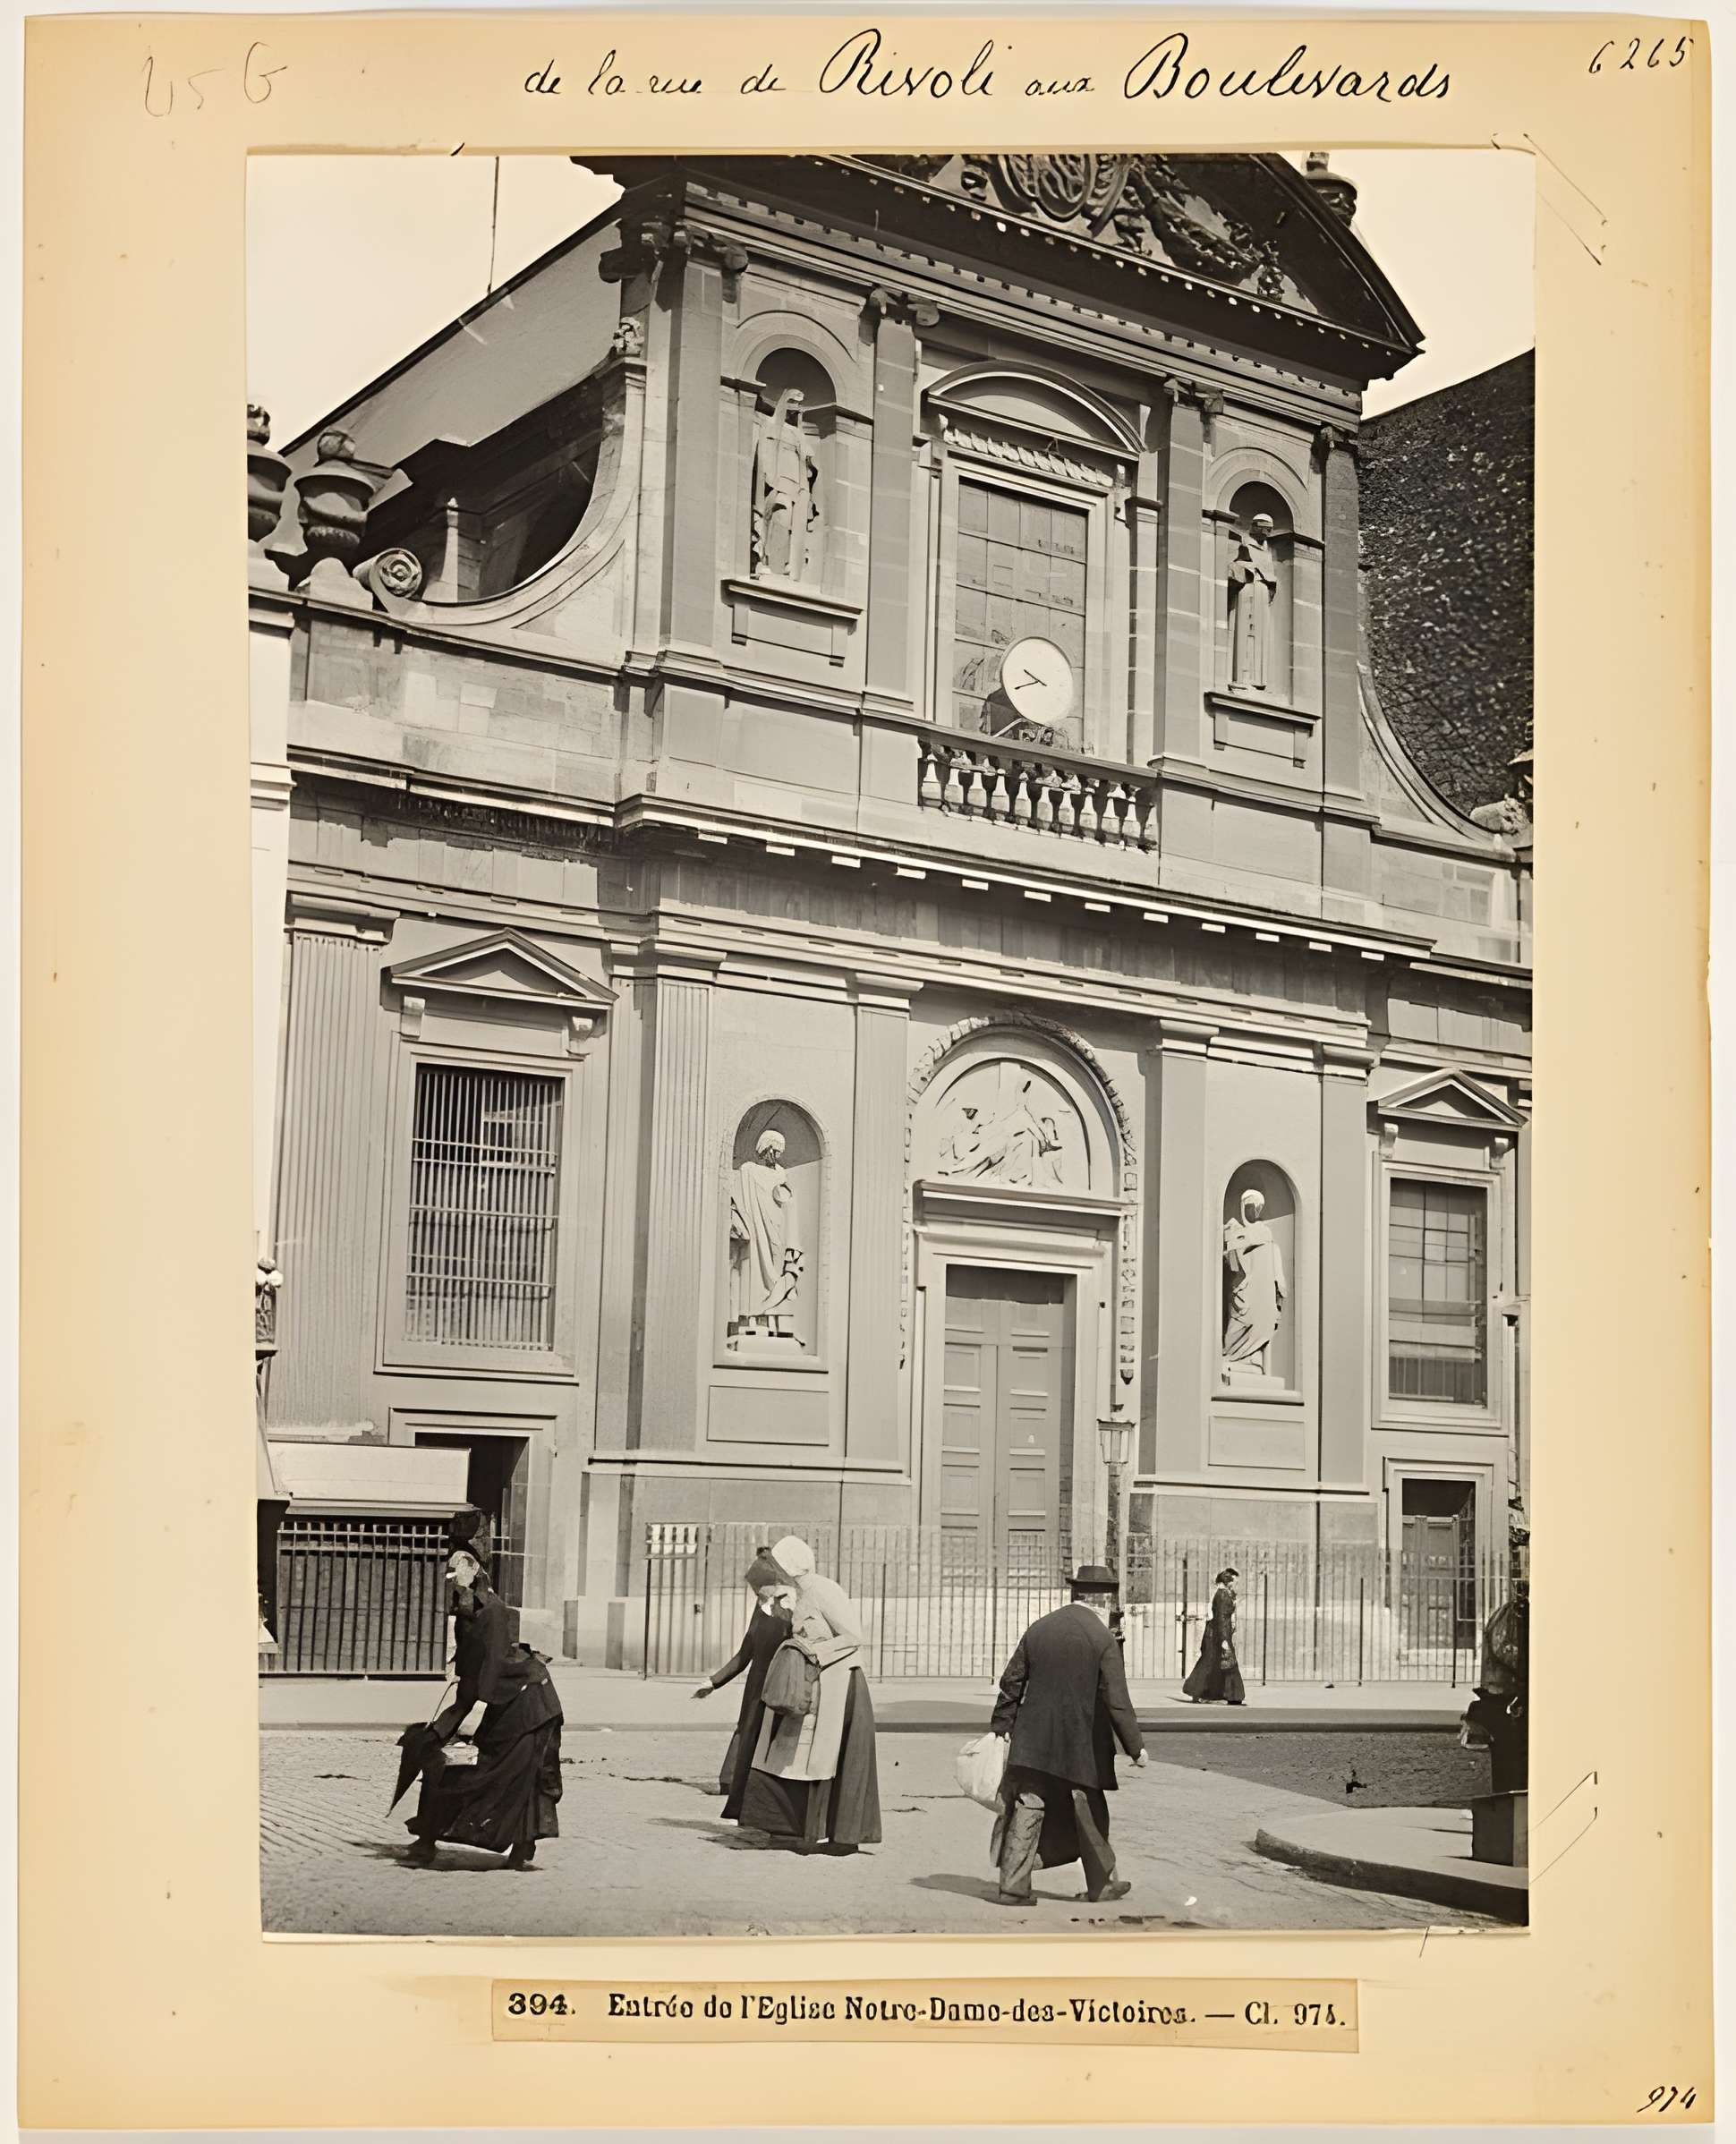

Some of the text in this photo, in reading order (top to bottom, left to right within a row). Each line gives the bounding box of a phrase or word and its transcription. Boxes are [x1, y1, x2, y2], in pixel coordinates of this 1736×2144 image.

[523, 28, 1451, 104] de la rue de Rivoli aux Boulevards
[507, 1992, 576, 2016] 394.
